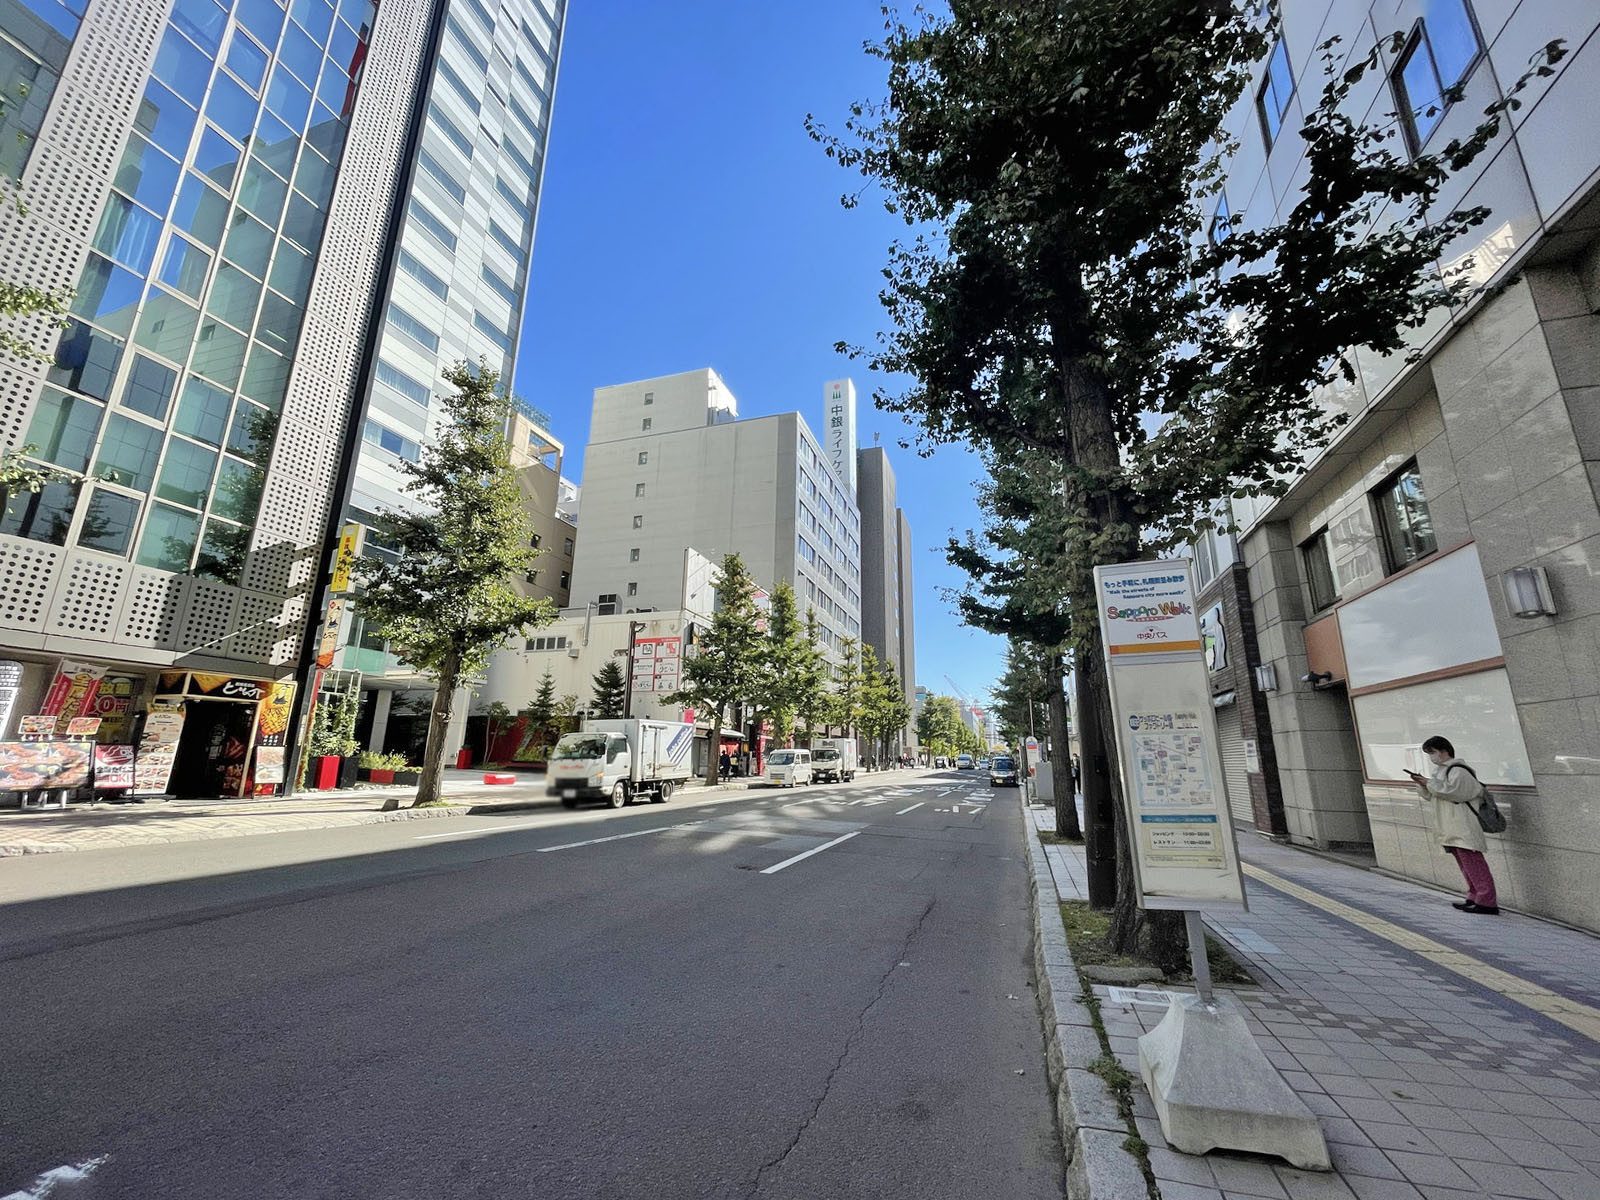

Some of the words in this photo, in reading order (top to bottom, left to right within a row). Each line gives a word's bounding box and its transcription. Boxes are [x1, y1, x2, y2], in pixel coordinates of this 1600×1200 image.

[1107, 605, 1158, 620] Sapporo
[1157, 601, 1192, 616] Walk
[1137, 631, 1168, 640] 中央バス
